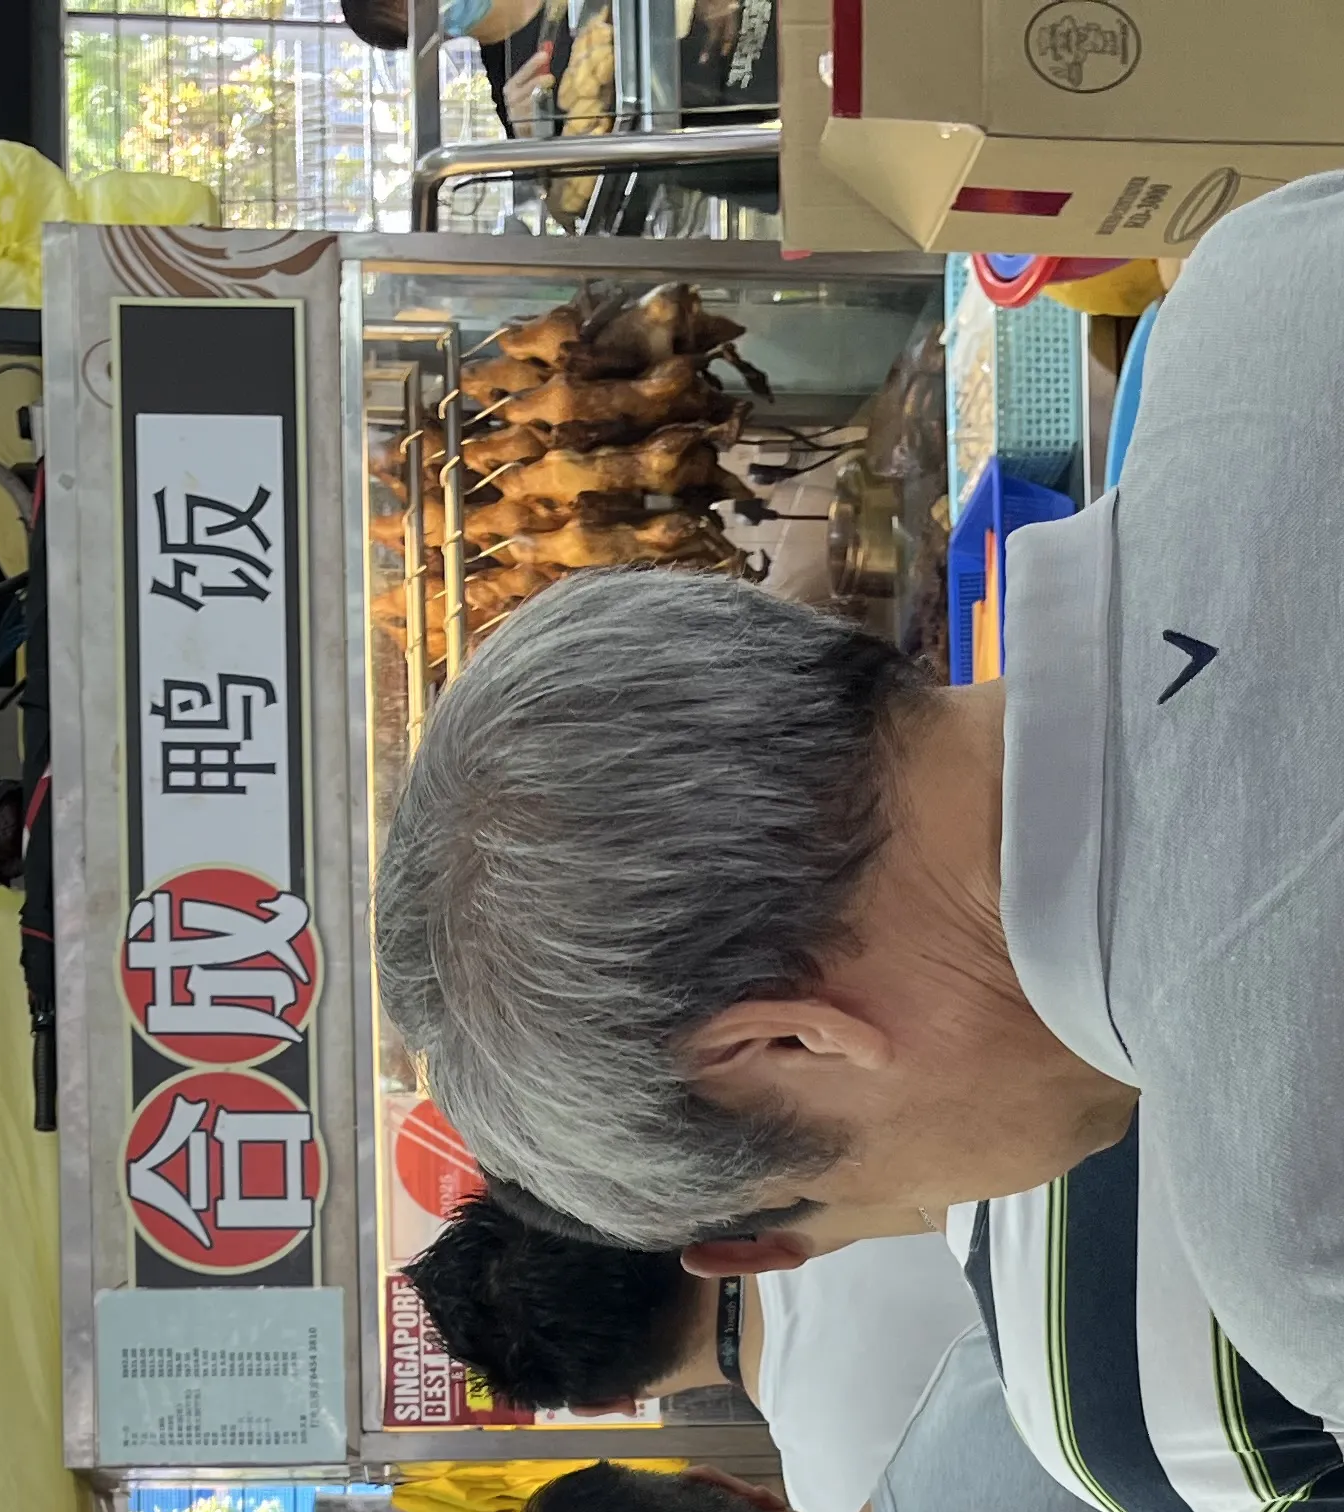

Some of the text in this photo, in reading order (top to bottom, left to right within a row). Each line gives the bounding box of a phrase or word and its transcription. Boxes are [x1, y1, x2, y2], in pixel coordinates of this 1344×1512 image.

[124, 484, 315, 1250] 合成鸭饭
[423, 1363, 447, 1417] BEST
